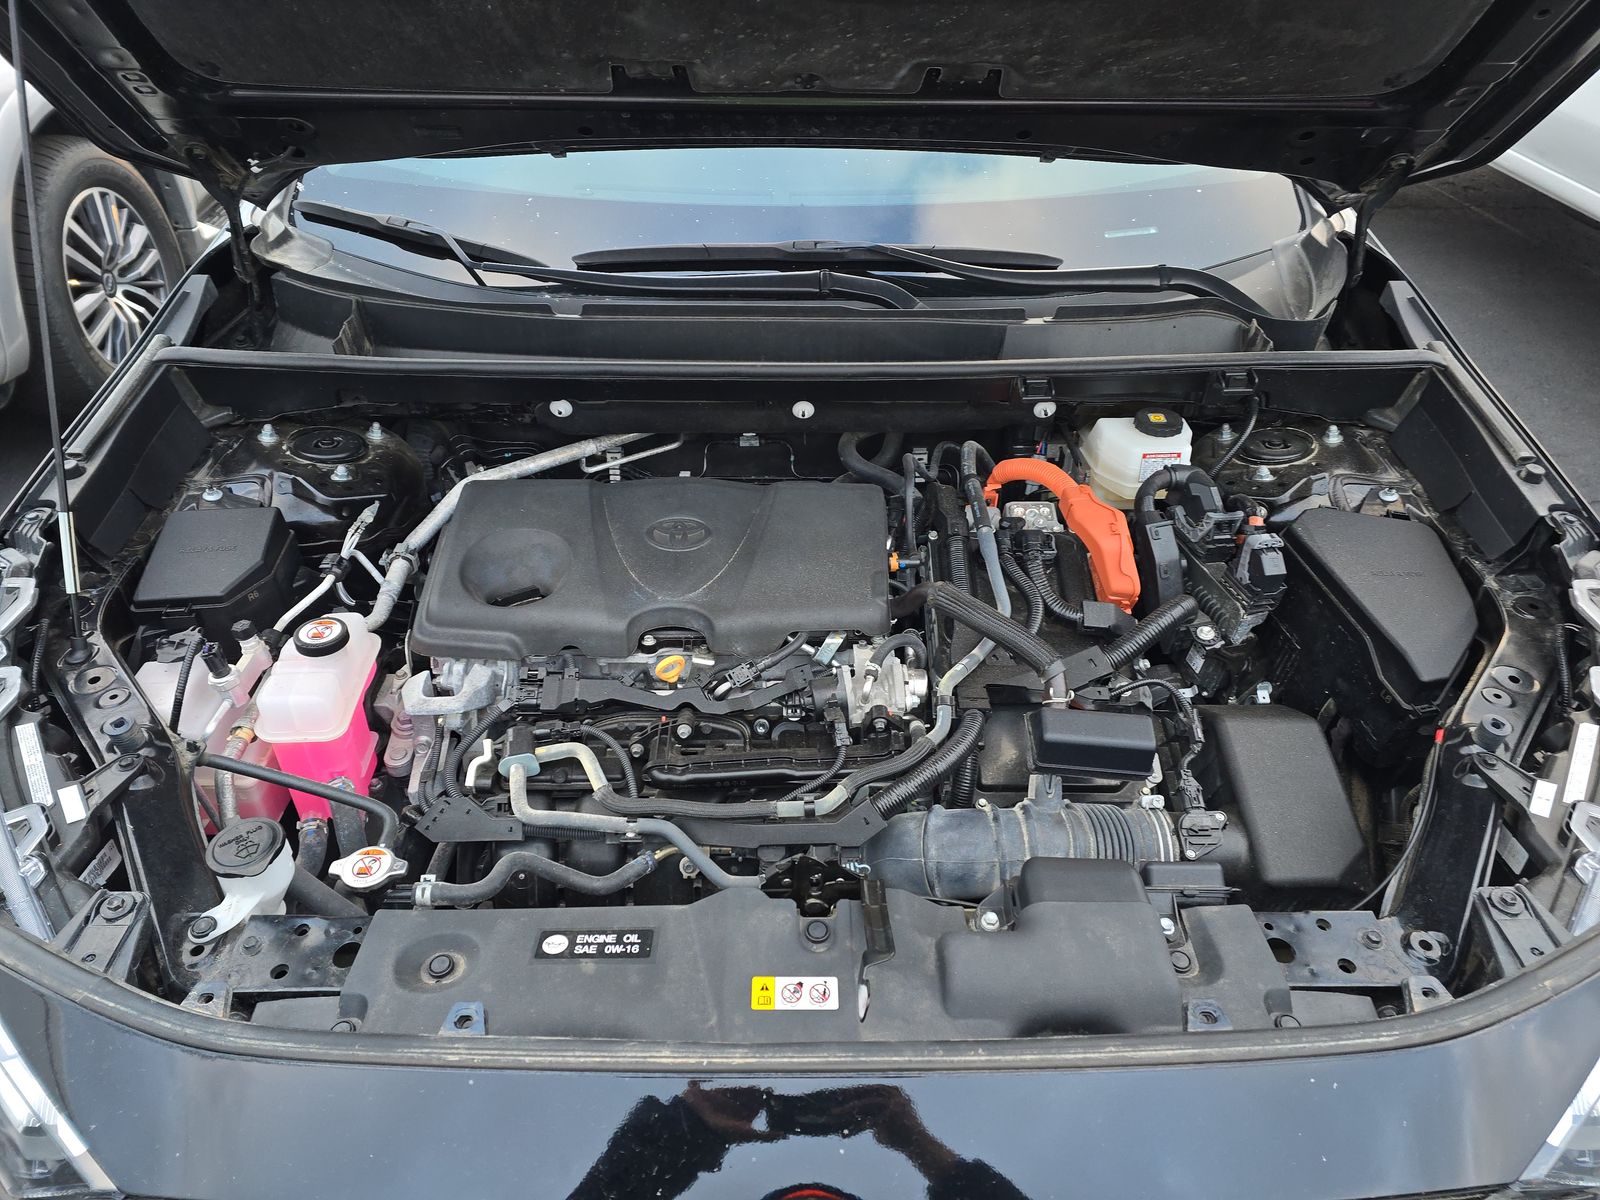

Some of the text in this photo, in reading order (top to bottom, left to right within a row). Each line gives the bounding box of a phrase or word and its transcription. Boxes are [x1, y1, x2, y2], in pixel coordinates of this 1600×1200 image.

[247, 590, 260, 602] R6
[576, 934, 641, 943] ENGINE OIL
[573, 945, 598, 954] SAE
[604, 944, 640, 954] 0W-16
